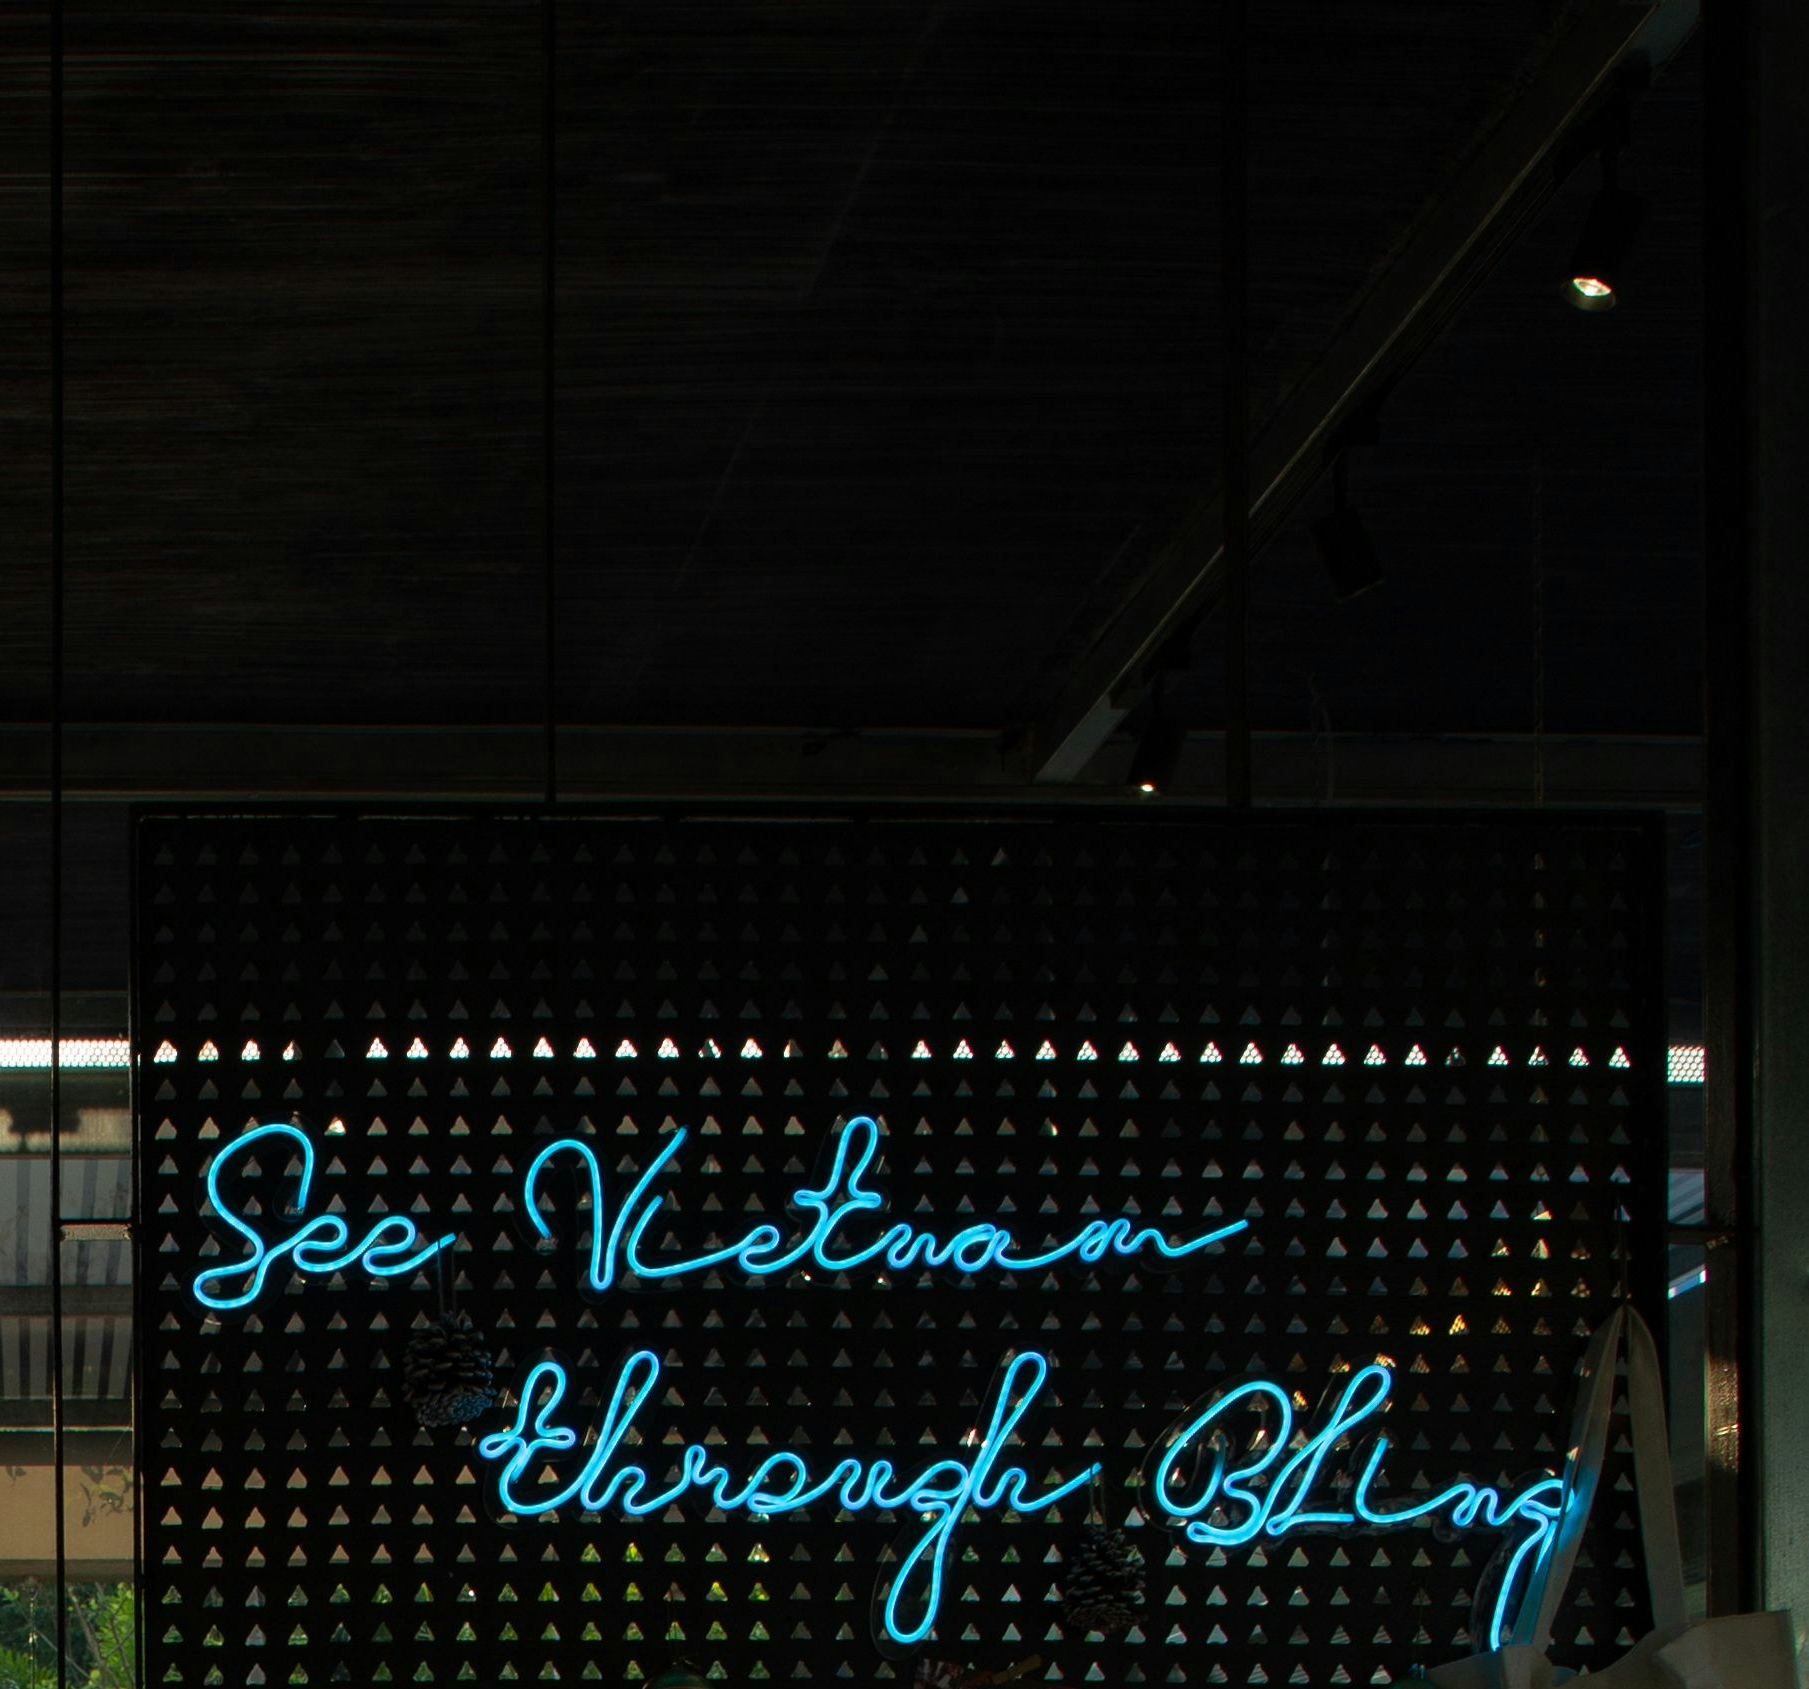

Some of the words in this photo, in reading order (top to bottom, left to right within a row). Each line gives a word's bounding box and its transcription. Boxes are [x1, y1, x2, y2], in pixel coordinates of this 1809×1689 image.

[191, 1122, 458, 1312] See
[522, 1113, 1251, 1292] Vietnam
[476, 1348, 1103, 1646] through
